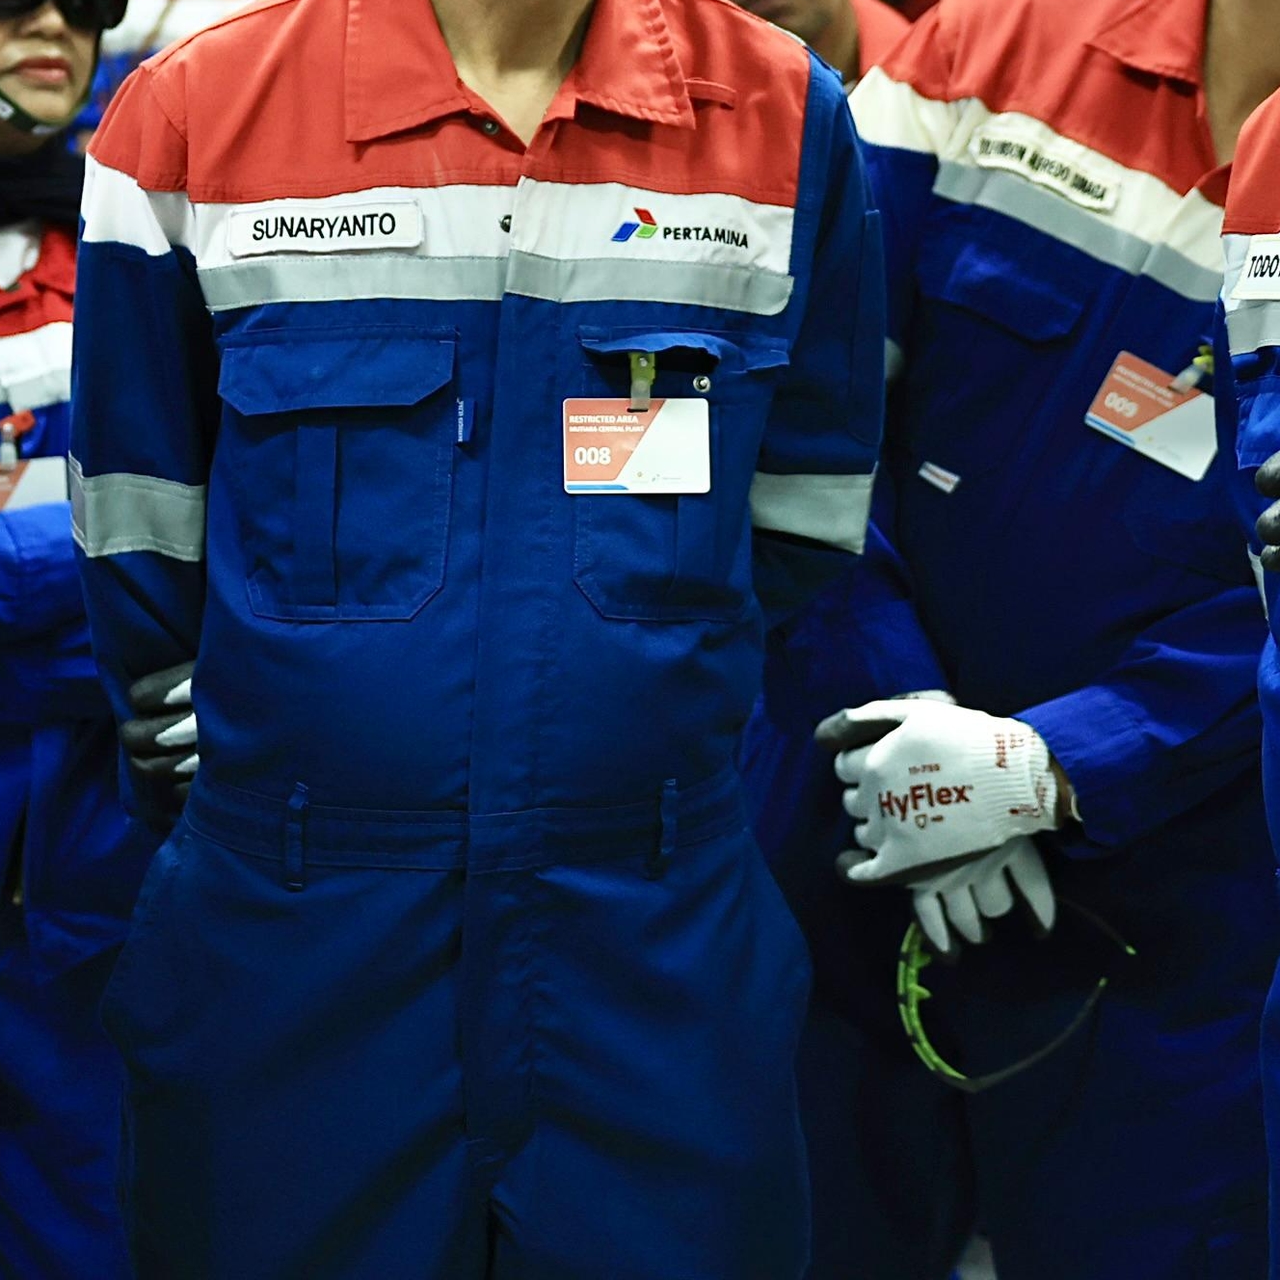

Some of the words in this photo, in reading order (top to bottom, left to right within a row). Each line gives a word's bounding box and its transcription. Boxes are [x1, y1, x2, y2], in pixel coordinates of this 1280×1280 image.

[252, 212, 396, 241] SUNARYANTO
[662, 227, 749, 248] PERTAMINA
[617, 415, 639, 424] AREA
[574, 446, 612, 465] 008
[878, 782, 970, 822] HyFlex
